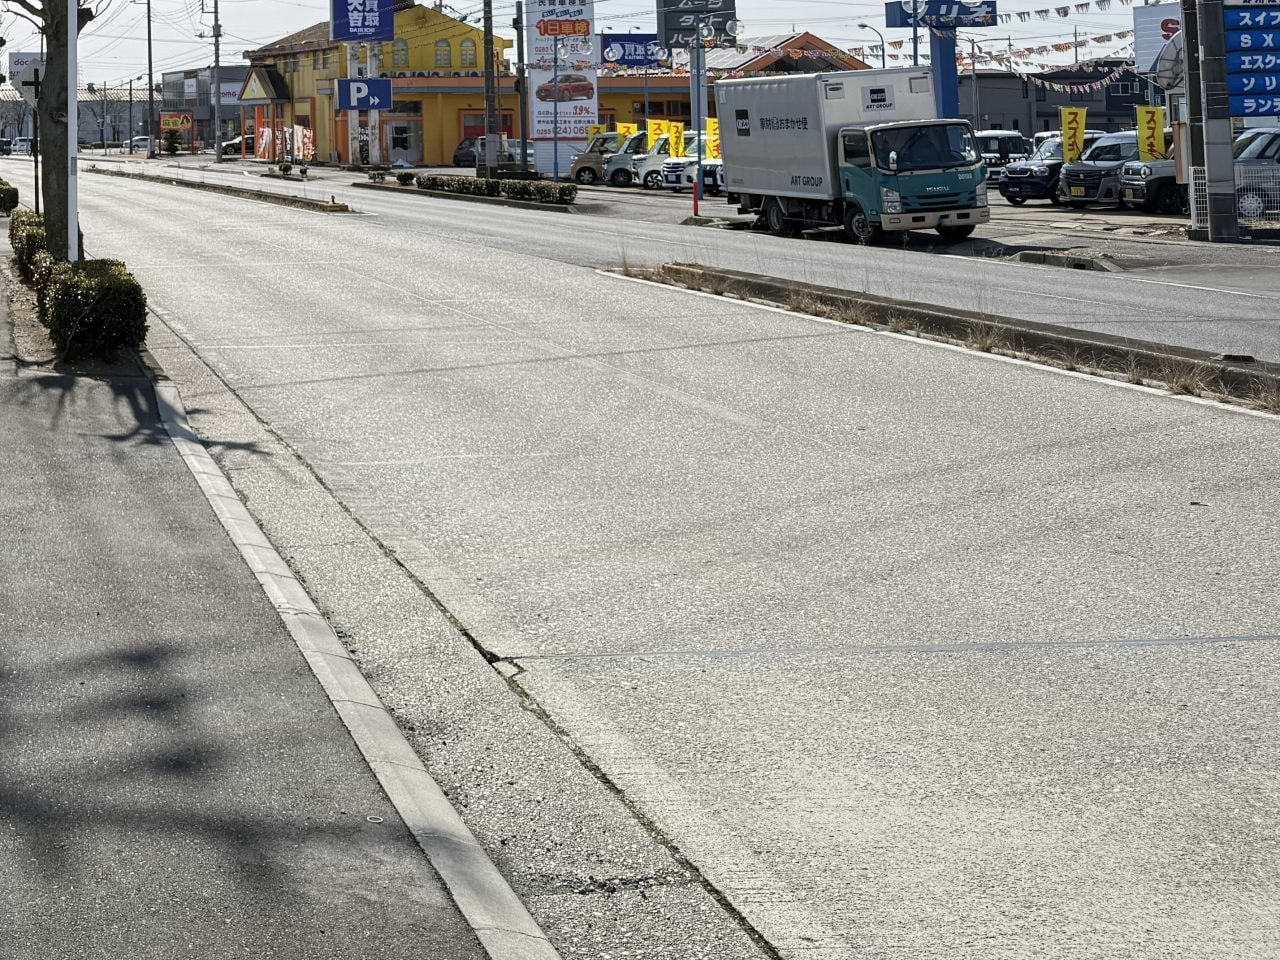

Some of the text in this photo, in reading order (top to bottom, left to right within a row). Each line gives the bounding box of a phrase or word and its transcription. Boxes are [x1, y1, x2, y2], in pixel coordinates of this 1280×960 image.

[537, 20, 589, 35] 1日車検
[349, 82, 369, 107] P
[791, 175, 823, 188] ART GROUP
